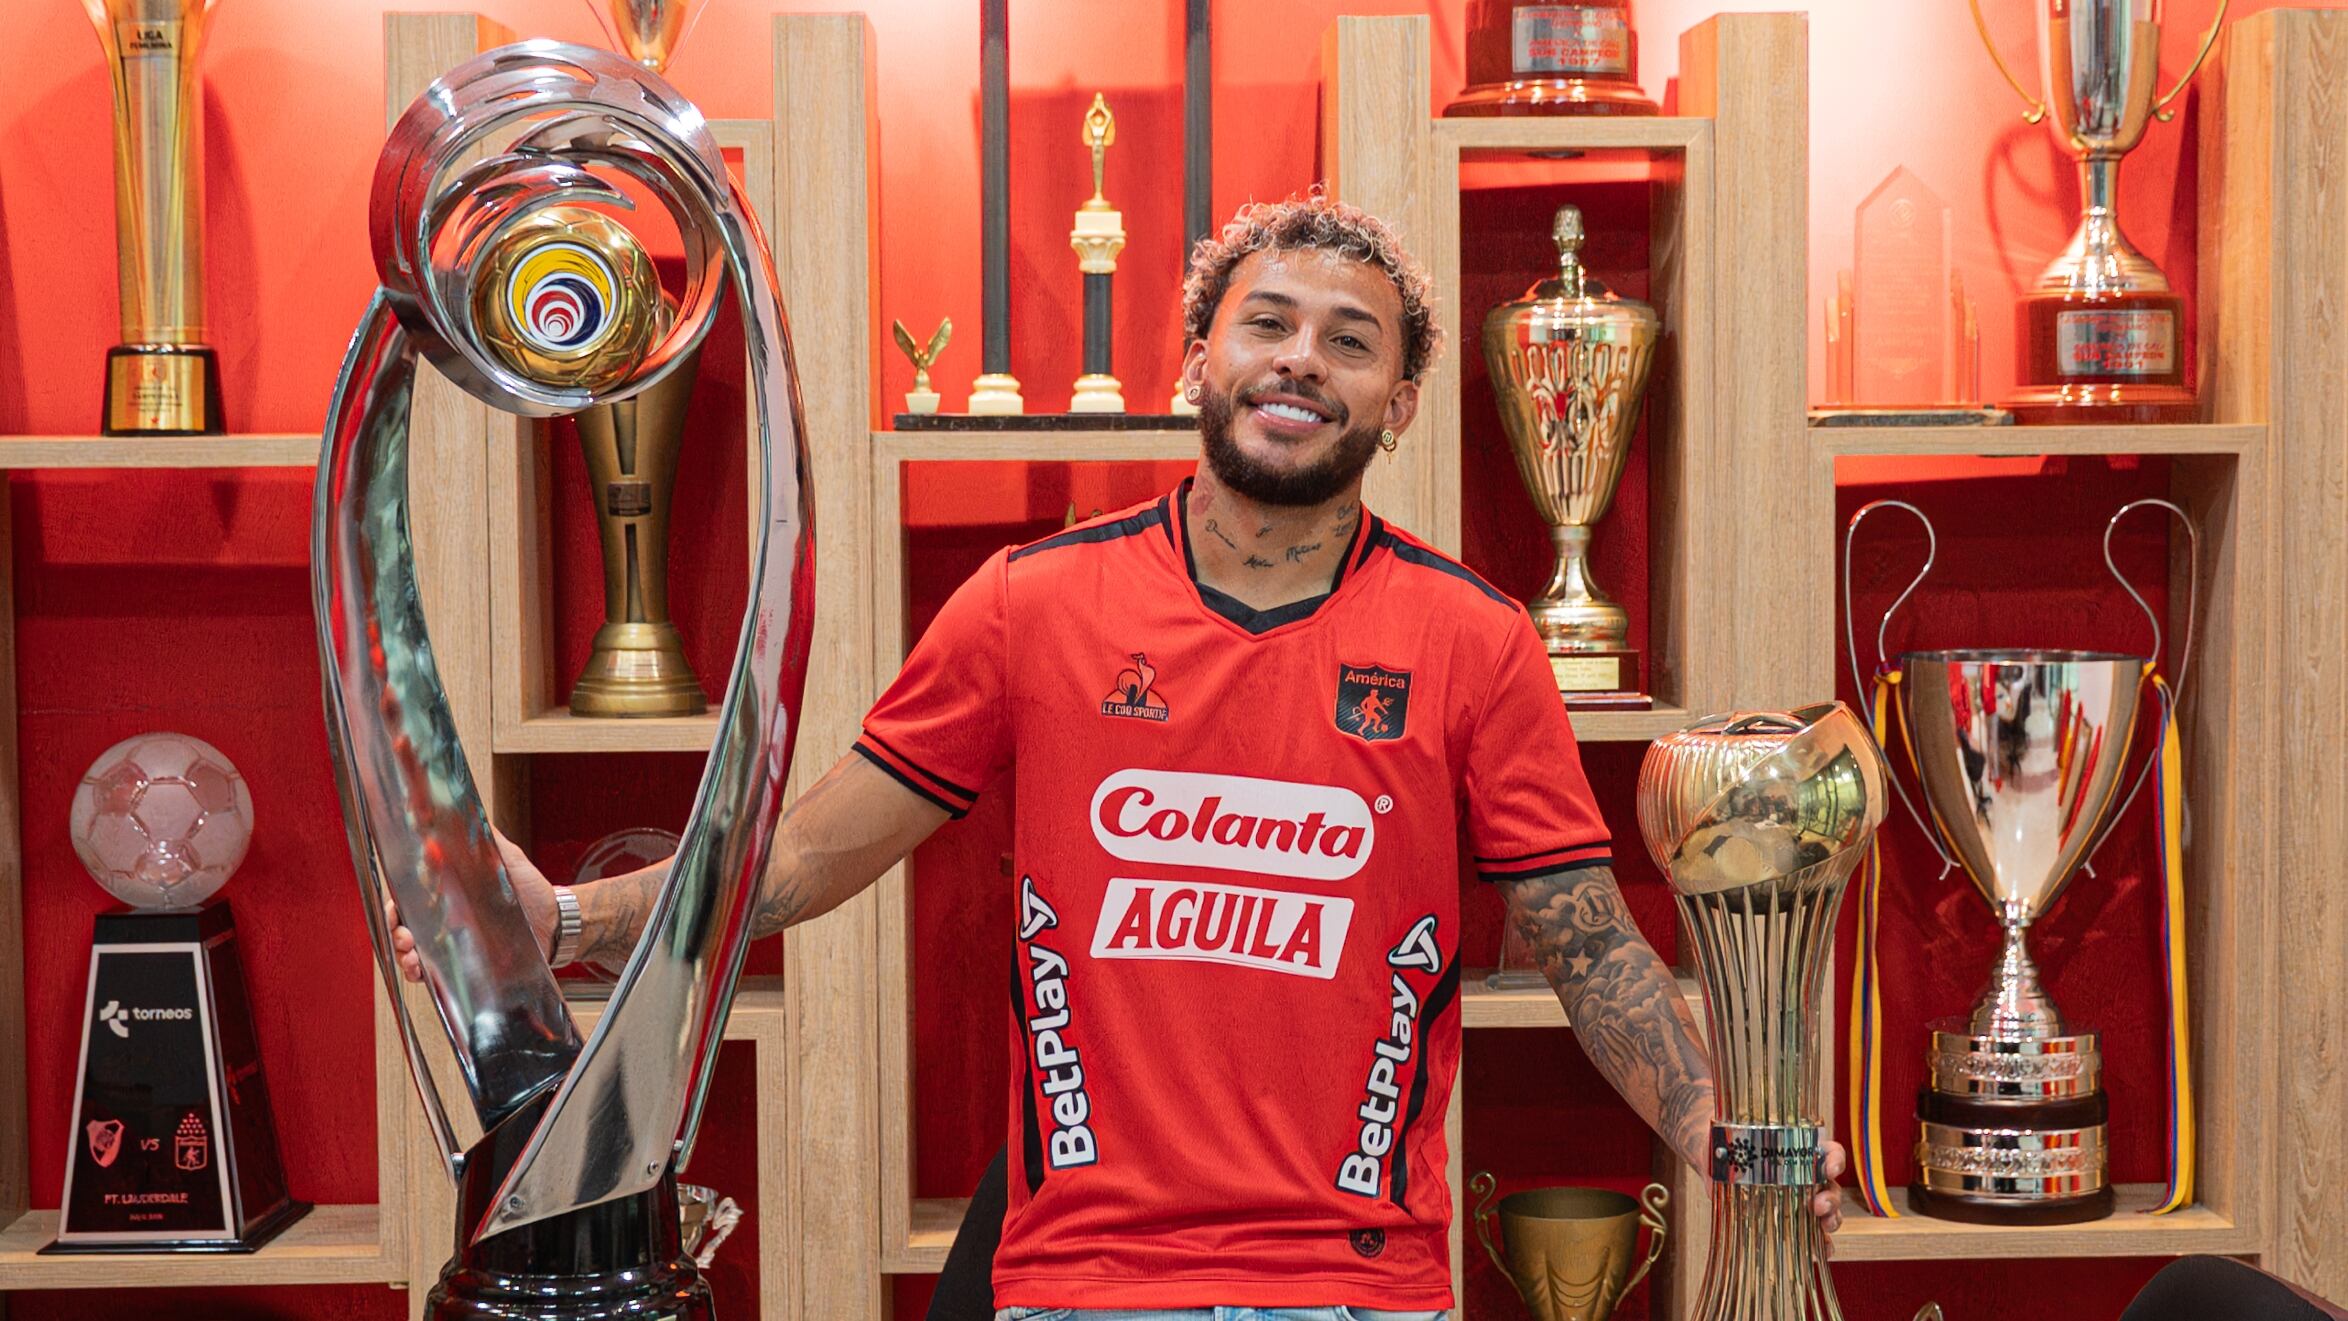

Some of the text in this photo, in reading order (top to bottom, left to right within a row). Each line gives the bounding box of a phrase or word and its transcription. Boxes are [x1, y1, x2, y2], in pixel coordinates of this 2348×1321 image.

[1344, 669, 1406, 690] América
[1102, 703, 1168, 720] LE COQ SPORTIF
[1099, 786, 1366, 860] Colanta
[1105, 887, 1325, 969] AGUILA
[132, 1006, 194, 1021] torneos
[1029, 944, 1097, 1168] BetPlay
[1337, 972, 1417, 1197] BetPlay
[1761, 1146, 1815, 1159] DIMAYOR
